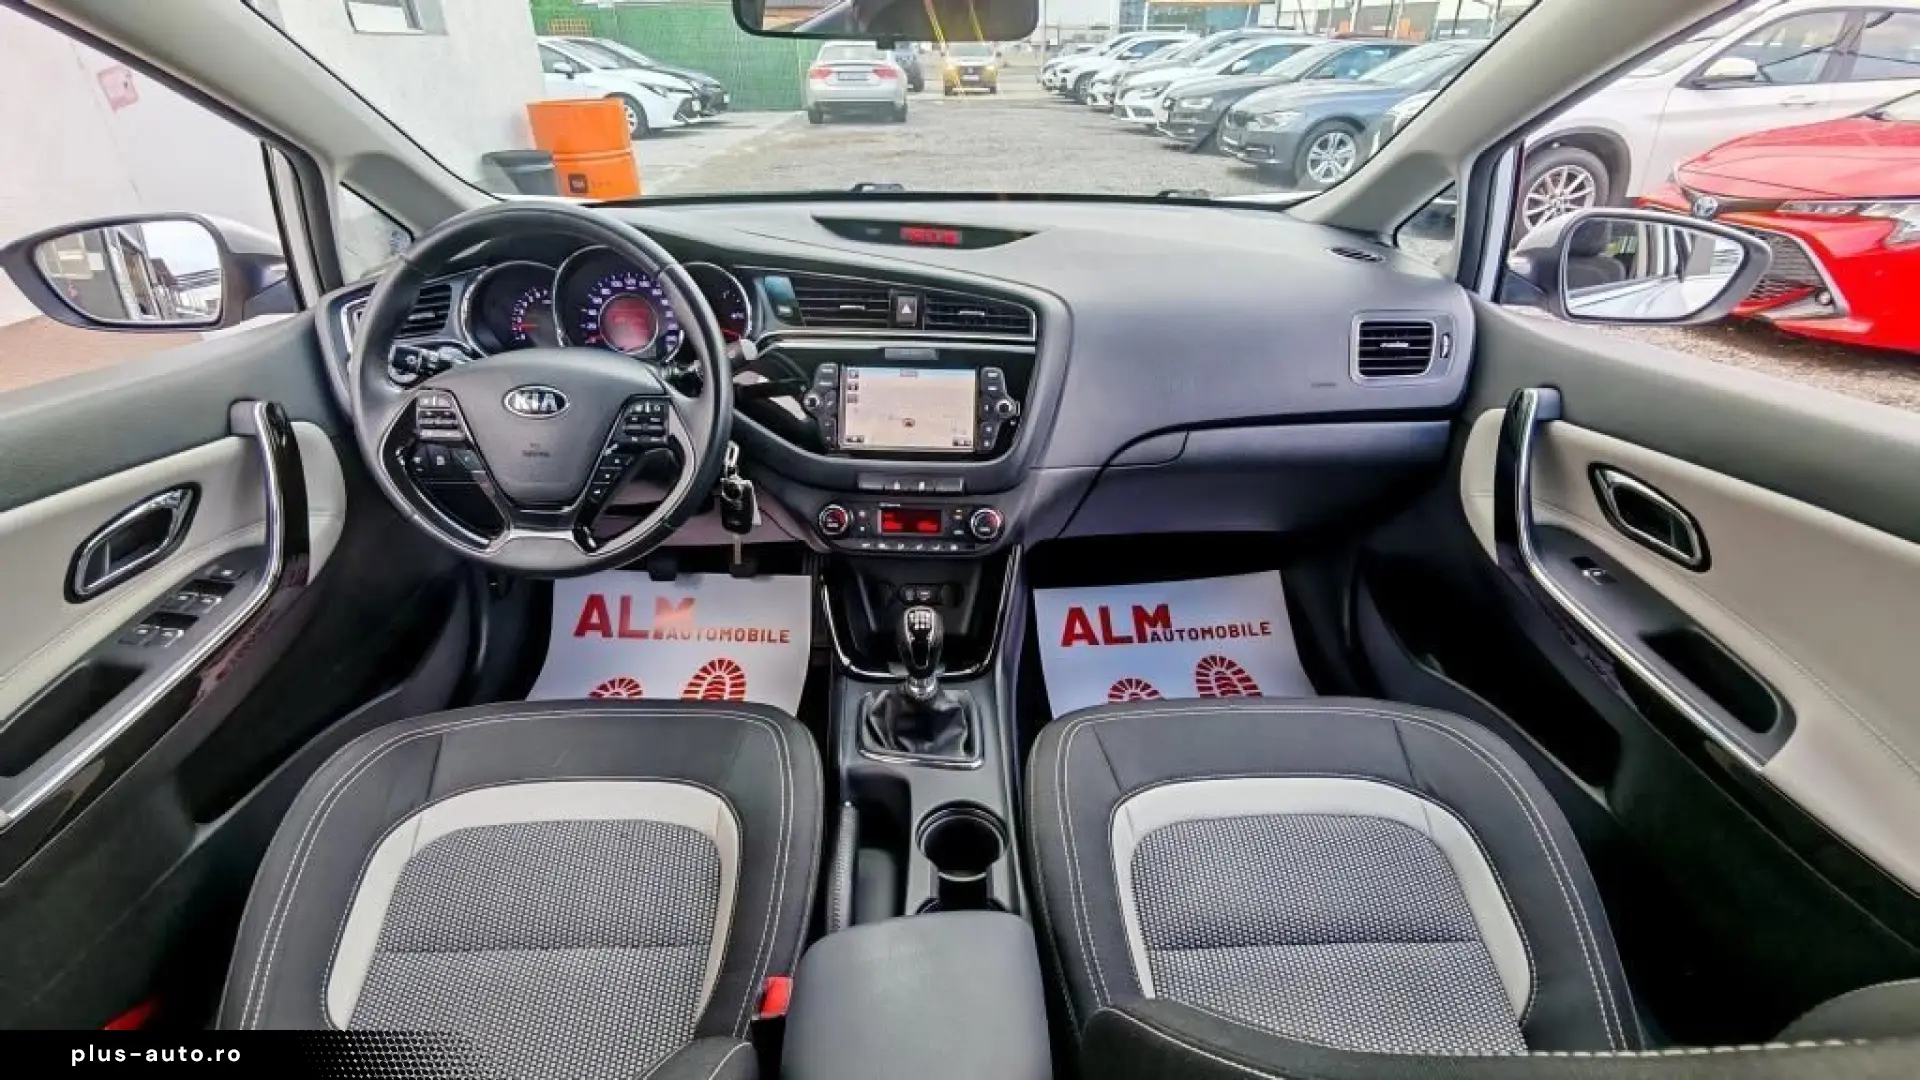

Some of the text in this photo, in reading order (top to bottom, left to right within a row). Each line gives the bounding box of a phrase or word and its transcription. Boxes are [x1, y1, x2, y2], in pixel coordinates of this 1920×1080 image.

[514, 393, 558, 411] KIA
[573, 593, 791, 644] ALM AUTOMOBILE
[1061, 603, 1272, 647] ALM AUTOMOBILE
